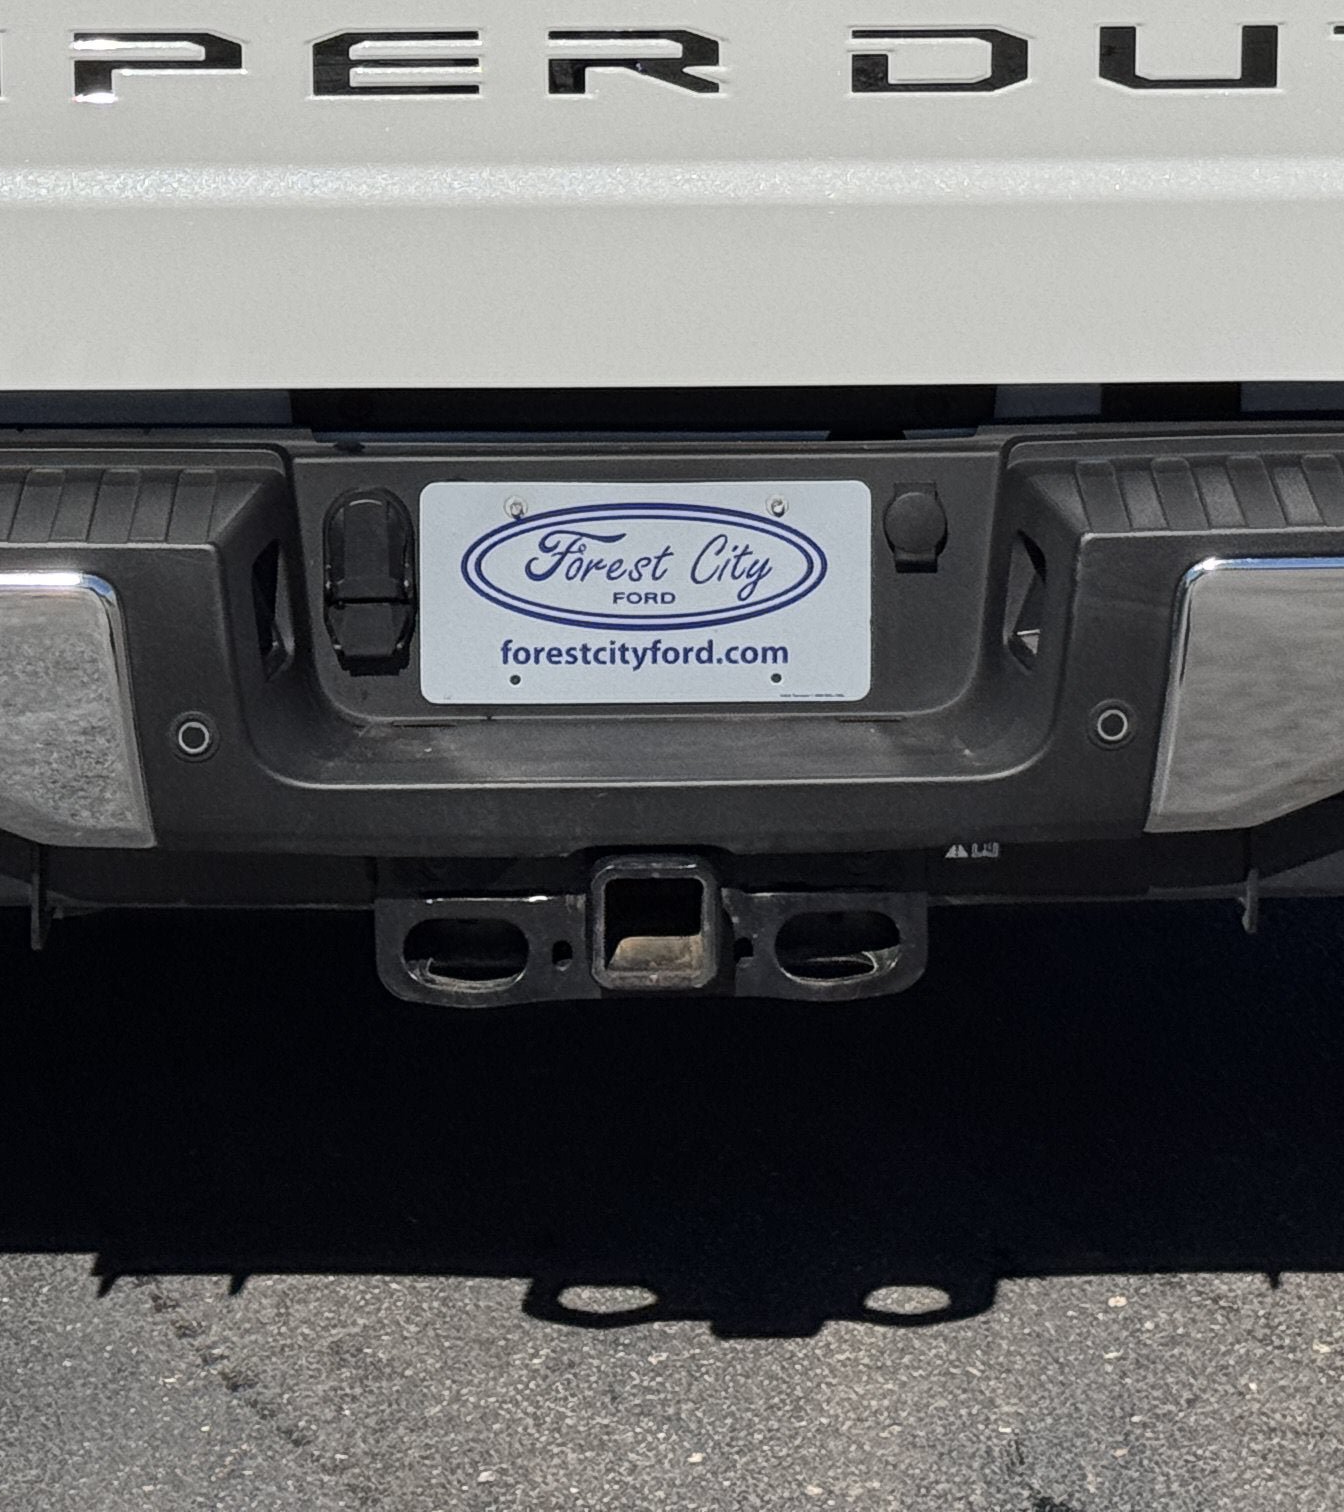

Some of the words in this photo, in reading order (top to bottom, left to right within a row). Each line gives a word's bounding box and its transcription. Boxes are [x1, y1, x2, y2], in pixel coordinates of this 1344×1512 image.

[524, 529, 675, 583] Forest
[689, 533, 773, 602] City
[612, 591, 676, 605] FORD
[500, 638, 790, 672] forestcityford.com
